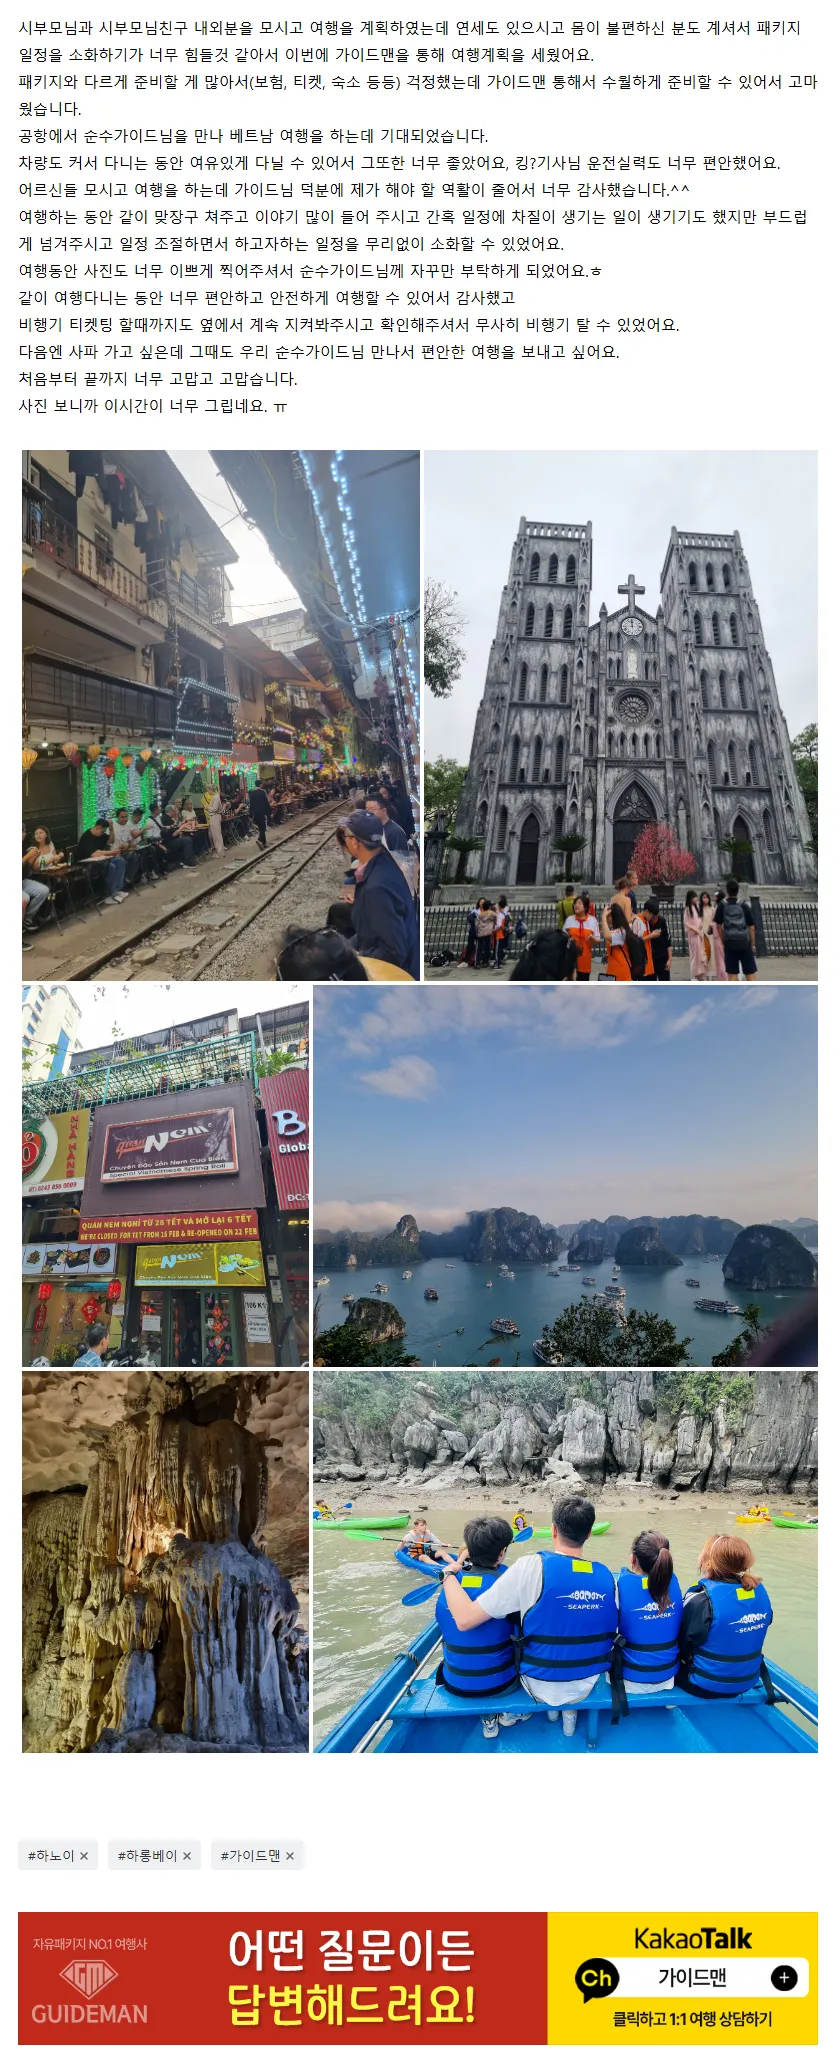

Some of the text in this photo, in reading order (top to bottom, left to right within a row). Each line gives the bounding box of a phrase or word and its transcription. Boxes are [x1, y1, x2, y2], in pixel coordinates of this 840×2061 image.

[168, 1230, 180, 1238] FEB
[186, 1229, 222, 1237] RE-OPENED
[223, 1228, 233, 1236] ON
[234, 1228, 243, 1236] 22
[244, 1227, 258, 1235] FEB
